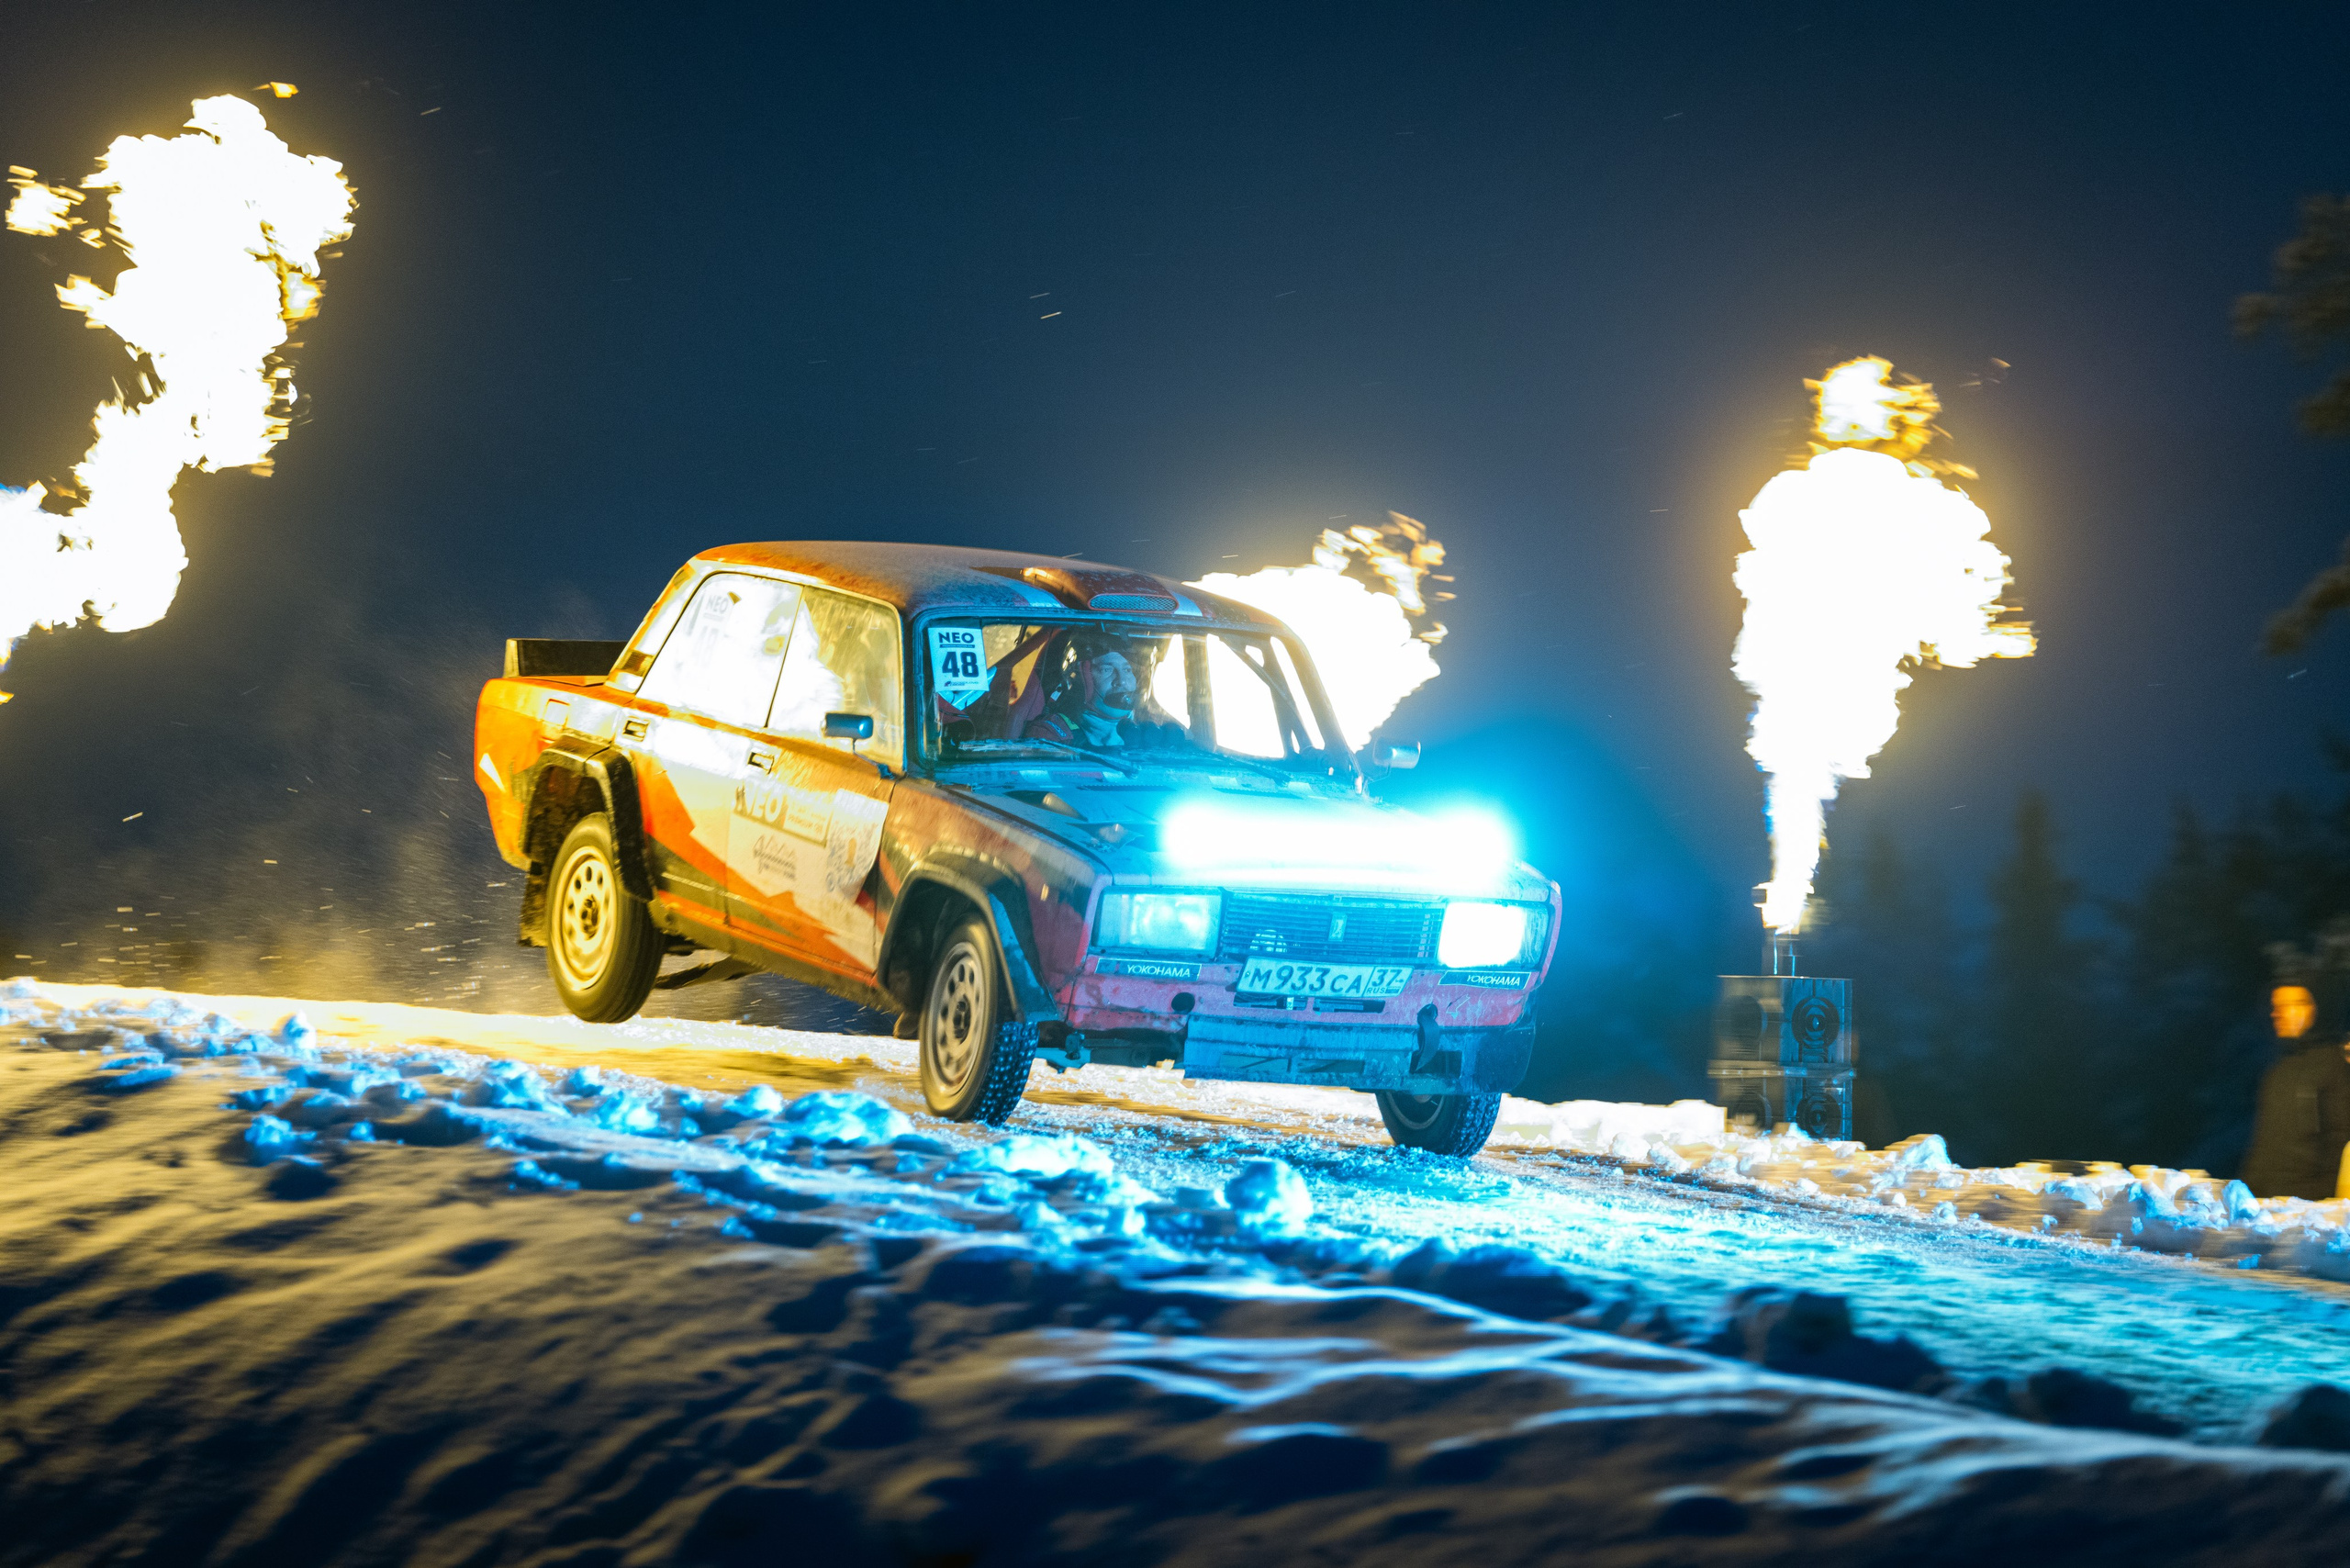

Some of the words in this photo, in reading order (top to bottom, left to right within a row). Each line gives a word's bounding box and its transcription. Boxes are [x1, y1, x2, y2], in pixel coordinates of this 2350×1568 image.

[707, 595, 729, 613] NEO
[938, 632, 975, 644] NEO
[942, 651, 979, 678] 48
[1127, 964, 1191, 978] YOKOHAMA
[1371, 969, 1402, 986] 37
[1467, 974, 1521, 987] YOKOHAMA
